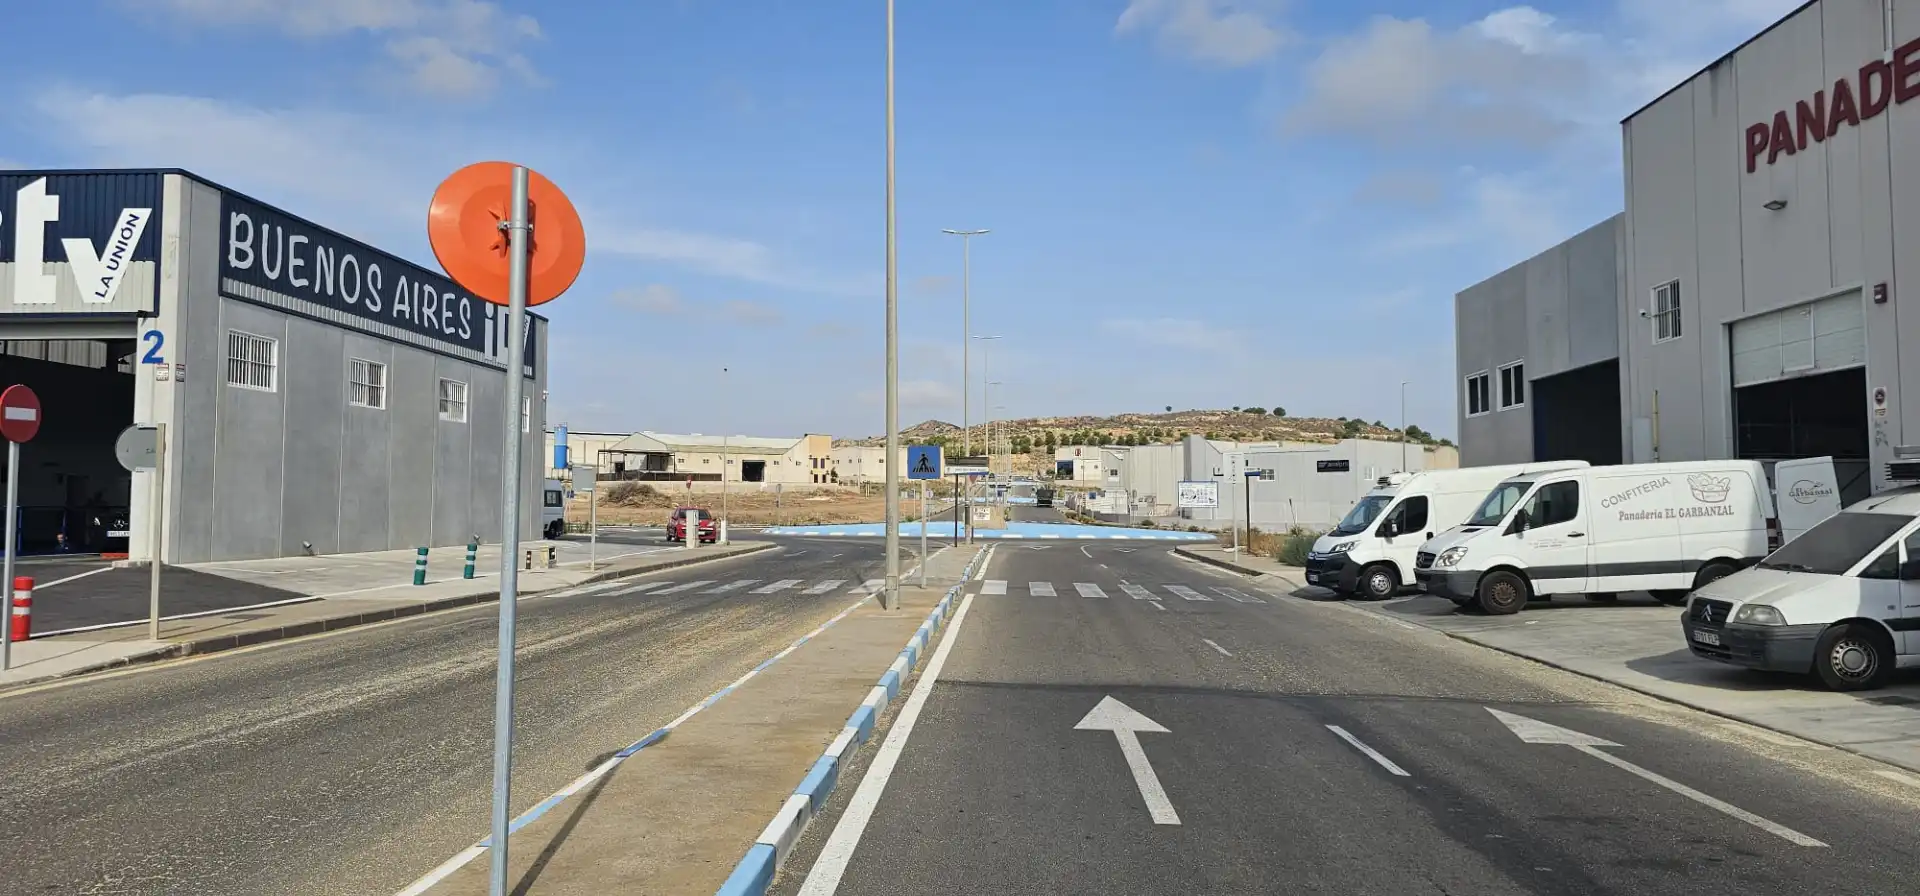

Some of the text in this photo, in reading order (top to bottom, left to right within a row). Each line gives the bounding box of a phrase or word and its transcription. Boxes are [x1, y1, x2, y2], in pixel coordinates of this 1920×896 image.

[1746, 36, 1920, 174] PANADE
[0, 176, 152, 304] tv
[95, 213, 141, 298] LA UNIÓN
[228, 211, 472, 340] BUENOS AIRES
[142, 329, 164, 364] 2
[1600, 477, 1671, 509] CONFITERIA
[1665, 508, 1677, 519] EL
[1678, 503, 1735, 518] GARBANZAL
